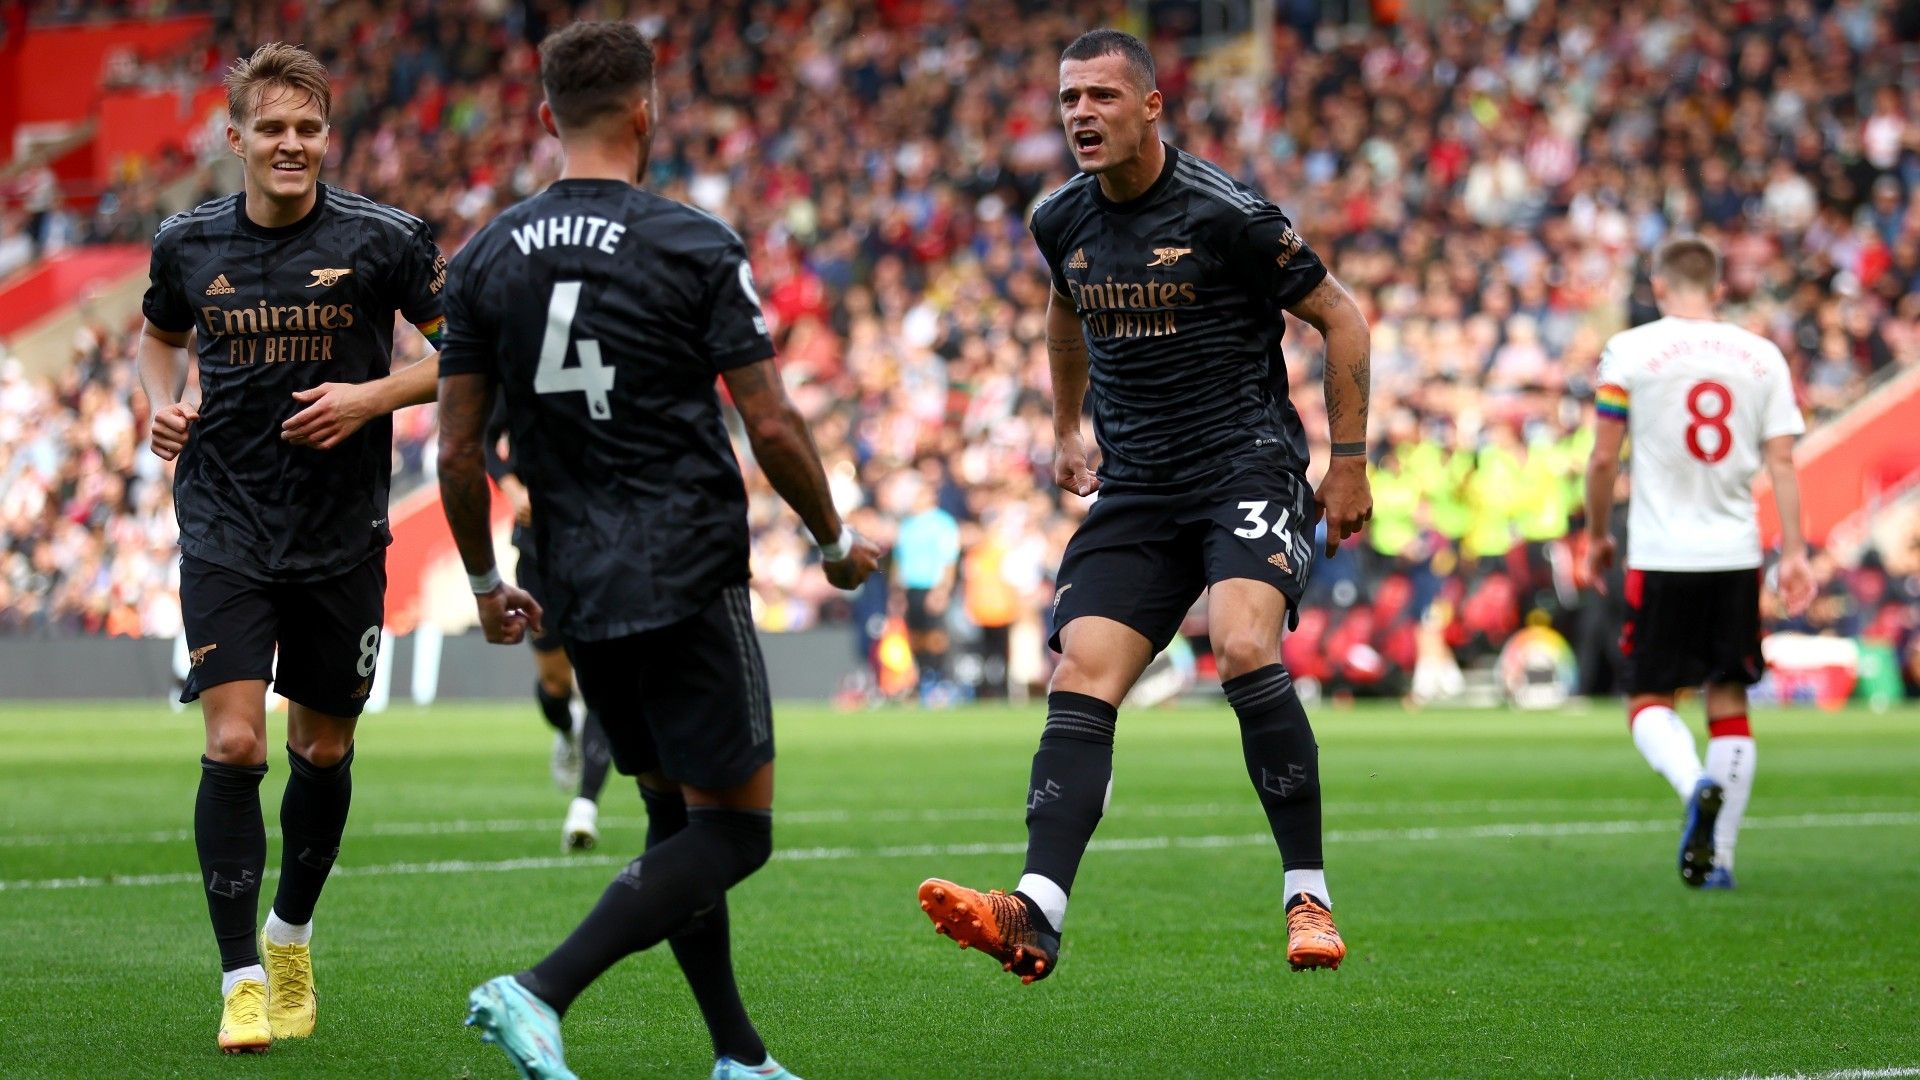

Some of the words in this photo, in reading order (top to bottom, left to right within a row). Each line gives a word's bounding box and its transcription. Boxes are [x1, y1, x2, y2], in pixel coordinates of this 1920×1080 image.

[512, 215, 627, 256] WHITE
[1066, 273, 1196, 312] Emirates
[201, 299, 354, 336] Emirates
[1114, 311, 1177, 338] BETTER
[229, 338, 258, 365] FLY
[264, 335, 333, 364] BETTER
[534, 281, 616, 420] 4
[1686, 380, 1732, 464] 8
[1233, 500, 1293, 557] 34
[356, 624, 380, 678] 8
